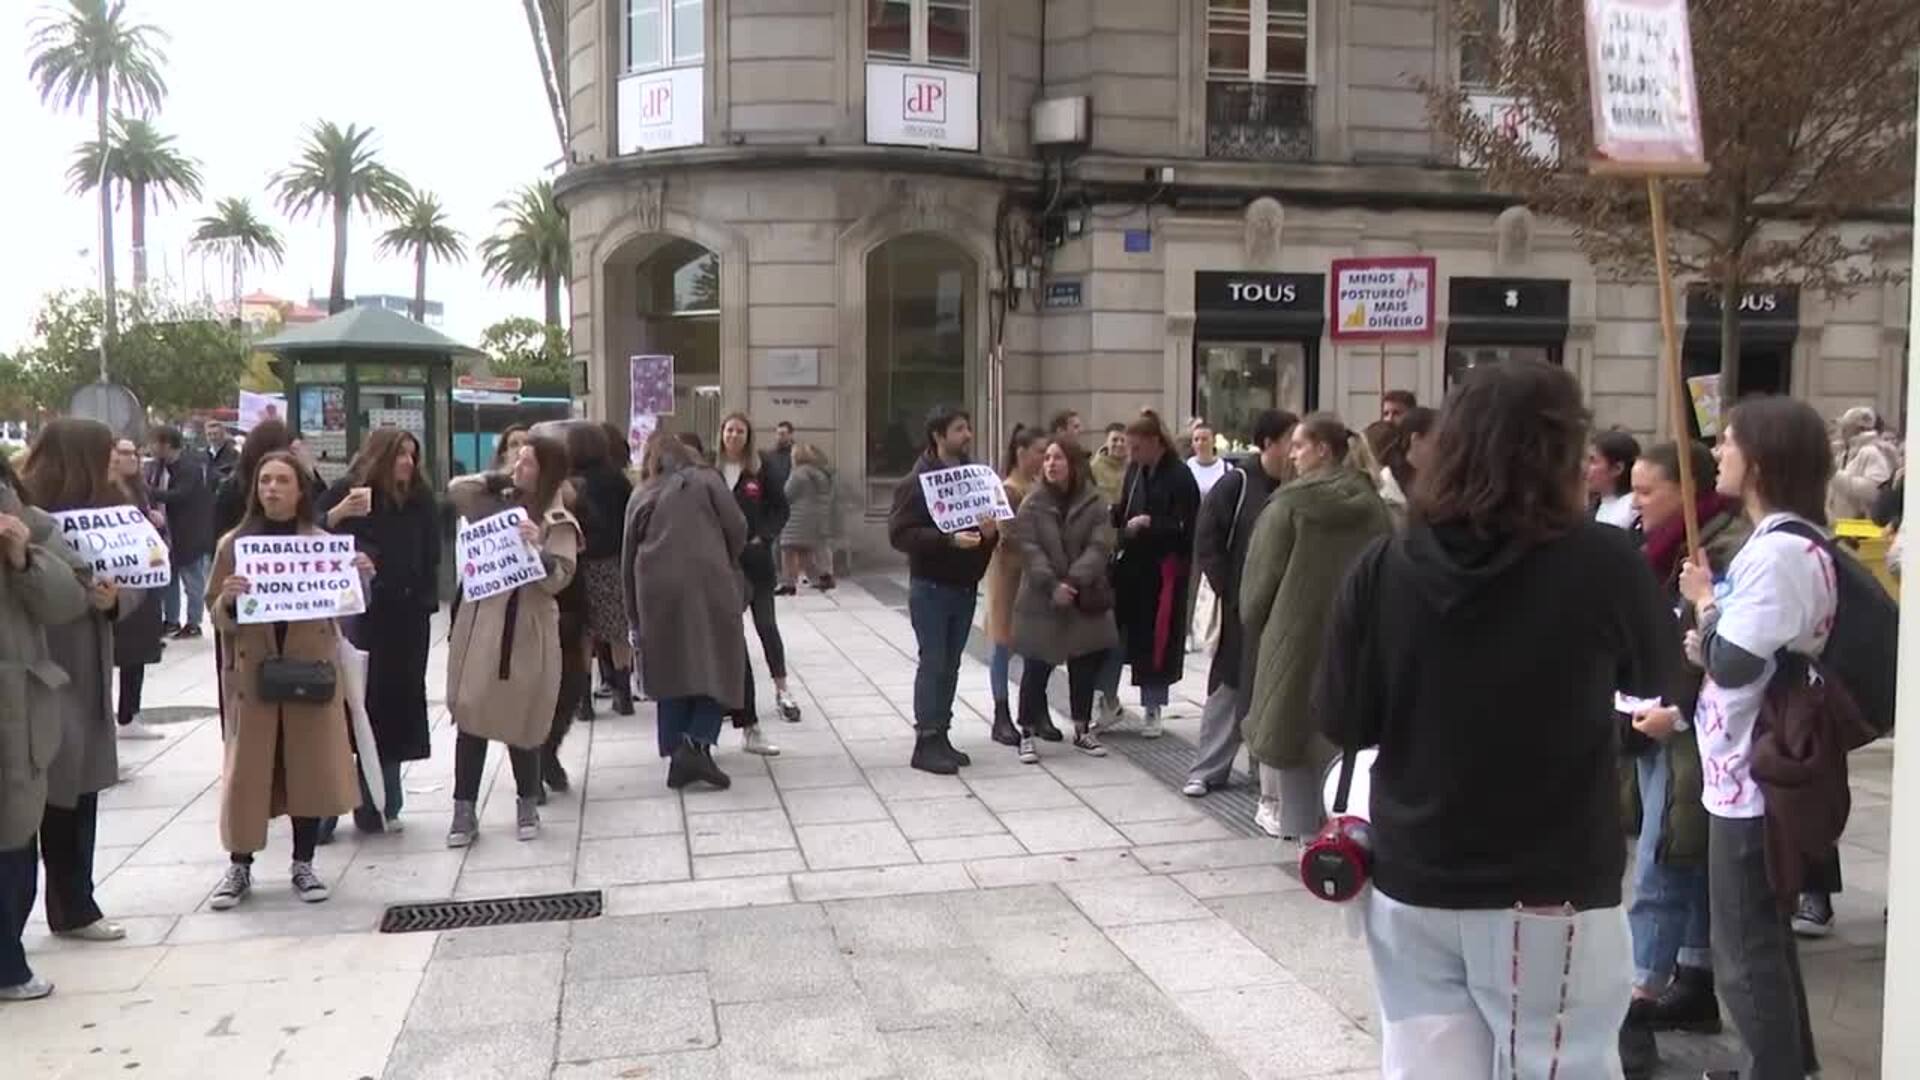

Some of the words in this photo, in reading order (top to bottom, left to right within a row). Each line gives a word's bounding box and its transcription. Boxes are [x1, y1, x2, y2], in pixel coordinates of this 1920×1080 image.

[1348, 273, 1396, 284] MENOS
[1227, 282, 1297, 302] TOUS
[1374, 301, 1409, 312] MAIS
[1368, 313, 1424, 327] DIÑEIRO
[926, 468, 993, 487] TRABALLO
[937, 486, 954, 499] EN
[948, 501, 971, 512] POR
[973, 496, 990, 506] UN
[461, 513, 520, 544] TRABALLO
[940, 515, 974, 531] OLDO
[242, 541, 325, 555] TRABALLO
[329, 541, 350, 553] EN
[467, 544, 481, 559] EN
[113, 554, 139, 568] UN
[246, 560, 342, 575] INDITEX
[477, 561, 497, 575] POR
[498, 553, 519, 569] UN
[256, 580, 294, 594] NON
[297, 579, 350, 593] CHEGO
[468, 580, 501, 598] SOLDO
[265, 603, 272, 612] A
[275, 601, 293, 611] FIN
[295, 600, 310, 611] DE
